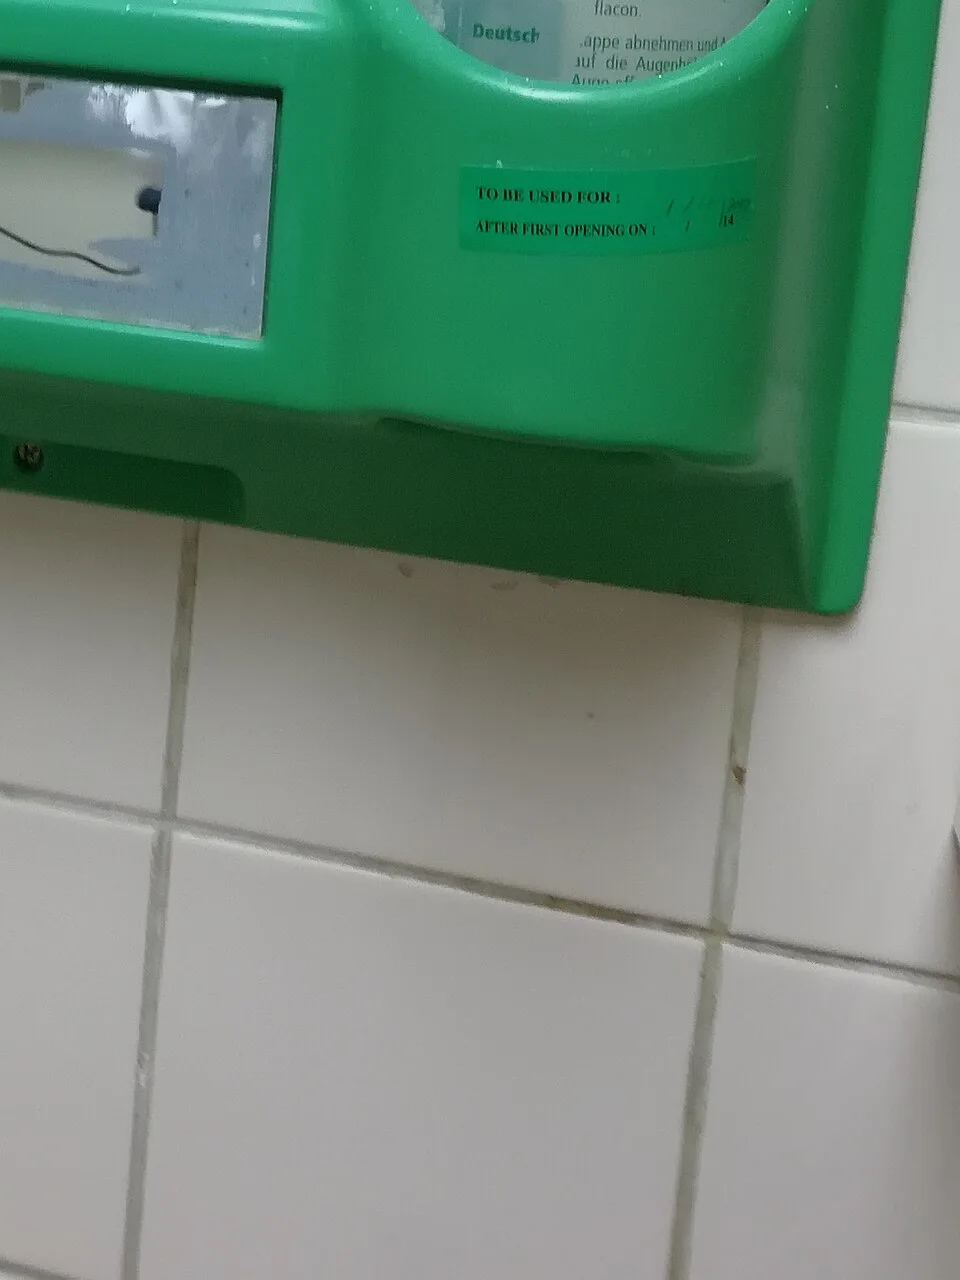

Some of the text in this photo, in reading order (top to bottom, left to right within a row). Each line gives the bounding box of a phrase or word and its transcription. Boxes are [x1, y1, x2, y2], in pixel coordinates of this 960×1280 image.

[473, 23, 694, 52] Deutsch abnehmen
[476, 187, 610, 204] TO BE USED FOR
[476, 219, 648, 237] AFTER FIRST OPENING ON
